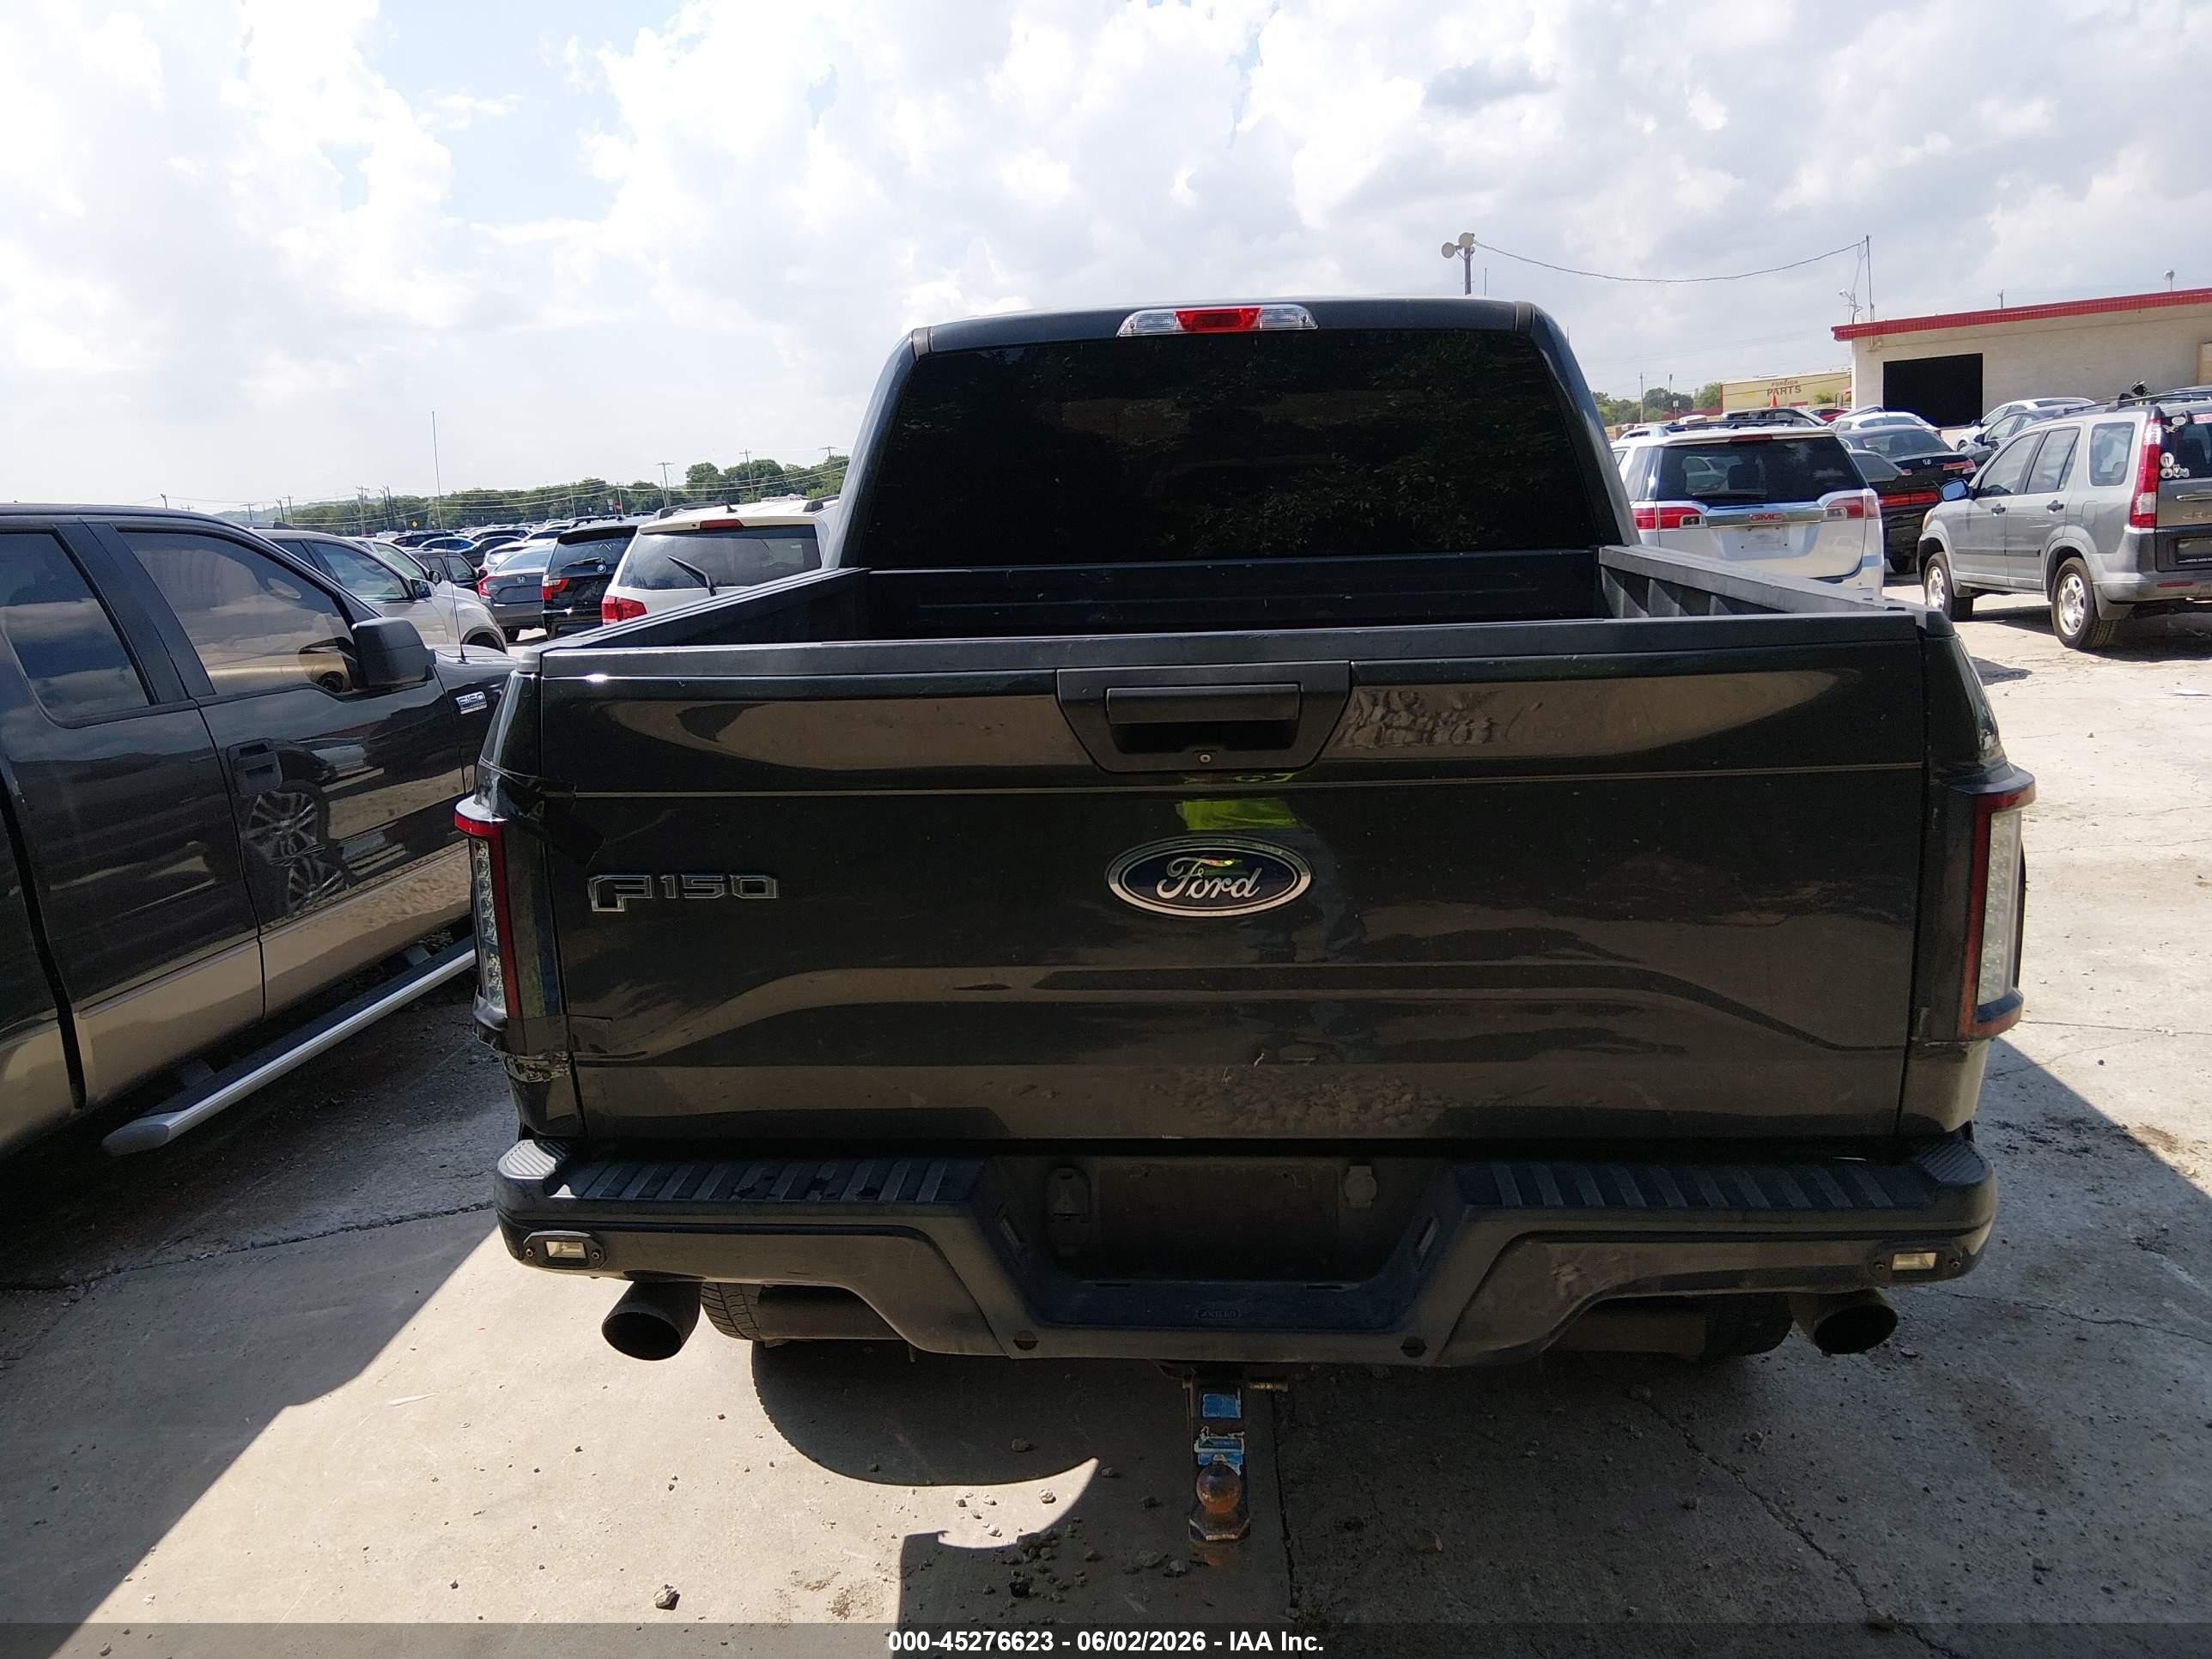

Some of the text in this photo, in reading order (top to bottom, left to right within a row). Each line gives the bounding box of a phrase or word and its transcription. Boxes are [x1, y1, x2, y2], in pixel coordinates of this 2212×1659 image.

[1767, 386, 1802, 396] PARTS
[1750, 513, 1781, 522] GMC
[1155, 855, 1263, 900] Ford
